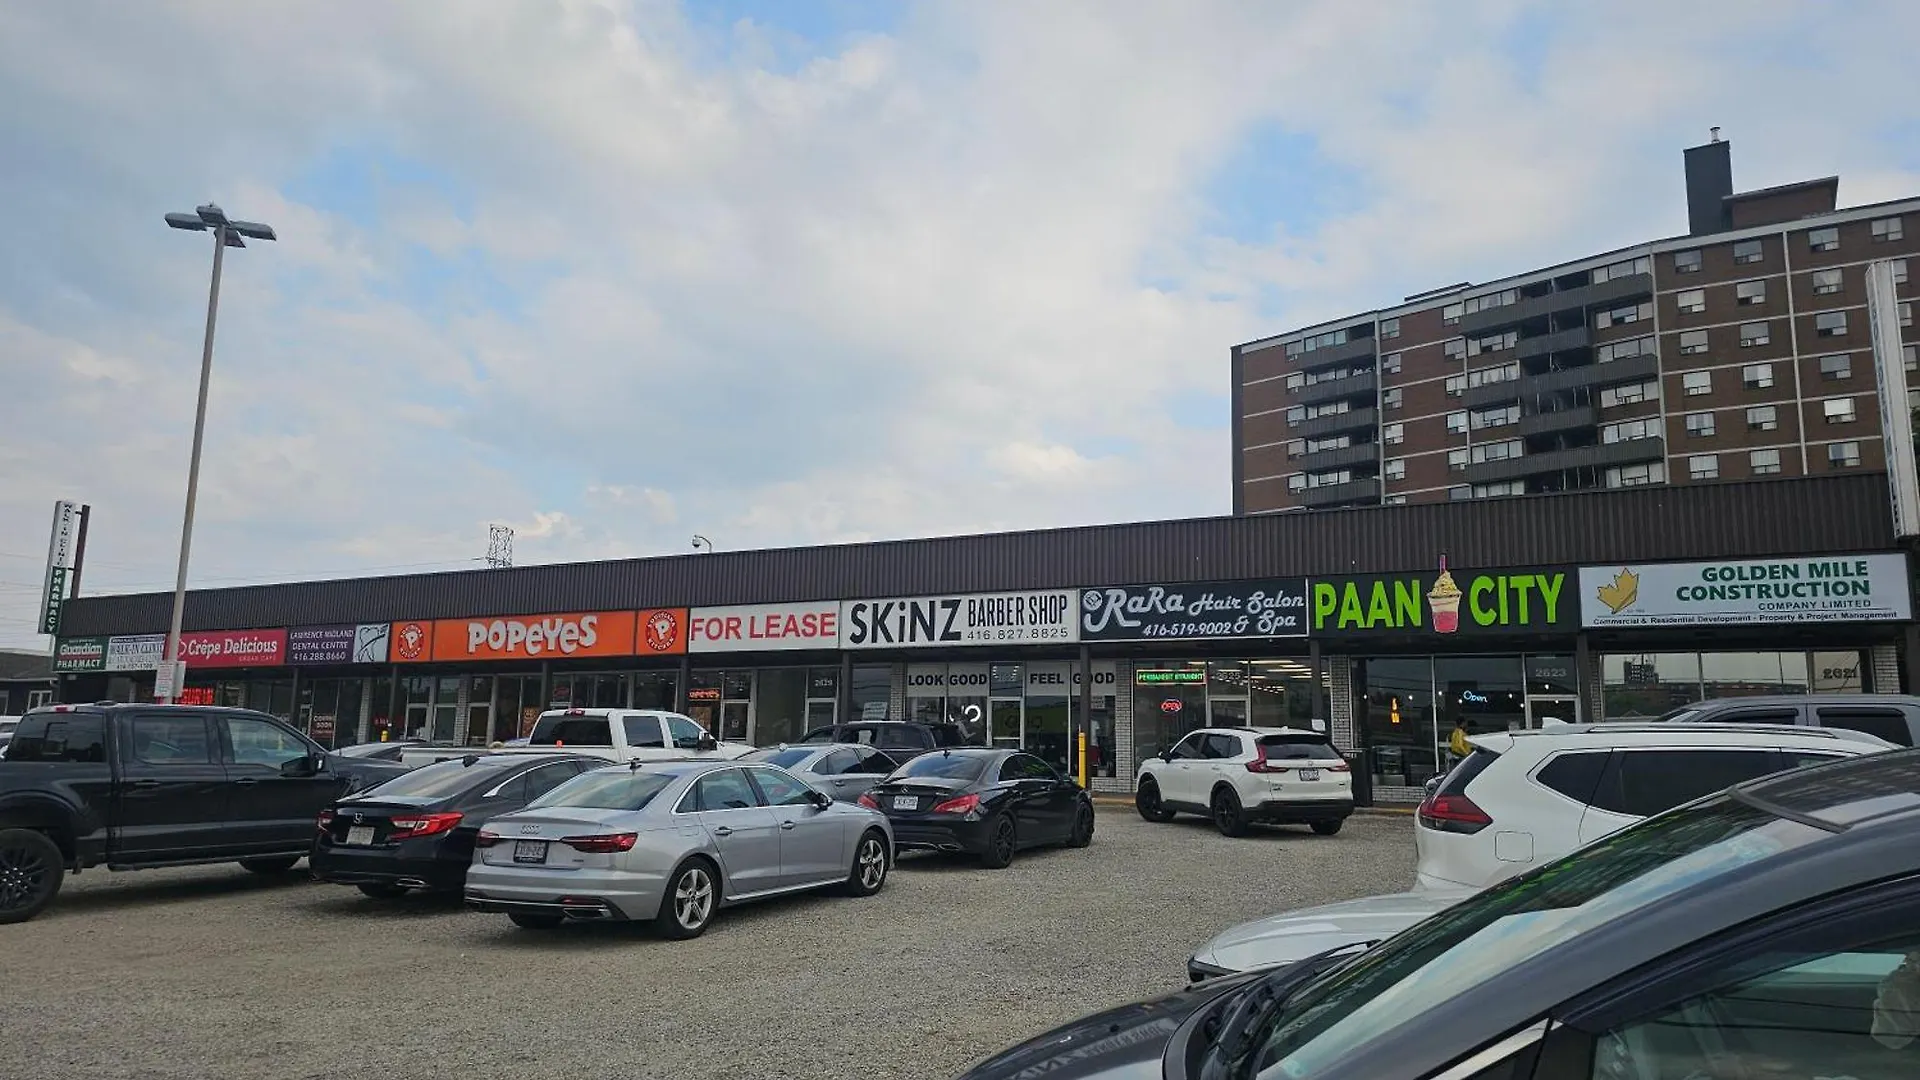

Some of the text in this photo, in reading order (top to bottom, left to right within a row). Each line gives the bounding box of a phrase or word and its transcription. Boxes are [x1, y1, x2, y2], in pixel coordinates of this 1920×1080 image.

[1702, 561, 1868, 582] GOLDEN MILE
[1676, 580, 1870, 601] CONSTRUCTION
[48, 569, 63, 632] PHARMACY
[1315, 573, 1565, 629] PAAN CITY
[1758, 599, 1871, 611] COMPANY LIMITED
[968, 597, 1025, 627] BARBER
[1028, 595, 1069, 625] SHOP
[1084, 586, 1185, 633] RaRa
[1188, 593, 1242, 616] Hair
[1247, 590, 1305, 615] Salon
[691, 613, 836, 641] FOR LEASE
[1233, 609, 1297, 635] & Spa
[1593, 617, 1640, 626] Commercial
[1650, 615, 1697, 625] Residential
[1698, 613, 1751, 624] Development
[1759, 613, 1796, 623] Property
[1806, 612, 1837, 622] Project
[1840, 611, 1898, 621] Management
[967, 627, 1069, 641] 416.827.8825
[1142, 620, 1231, 637] 416-519-9002
[60, 642, 103, 656] Guardian
[188, 636, 277, 660] Crêpe Delicious
[292, 641, 349, 650] DENTAL CENTRE
[57, 659, 101, 669] PHARMACY
[1535, 667, 1568, 678] 2623
[908, 674, 944, 686] LOOK
[949, 673, 988, 686] GOOD
[1030, 672, 1065, 684] FEEL
[1072, 672, 1115, 685] GOD
[1463, 690, 1488, 703] Open
